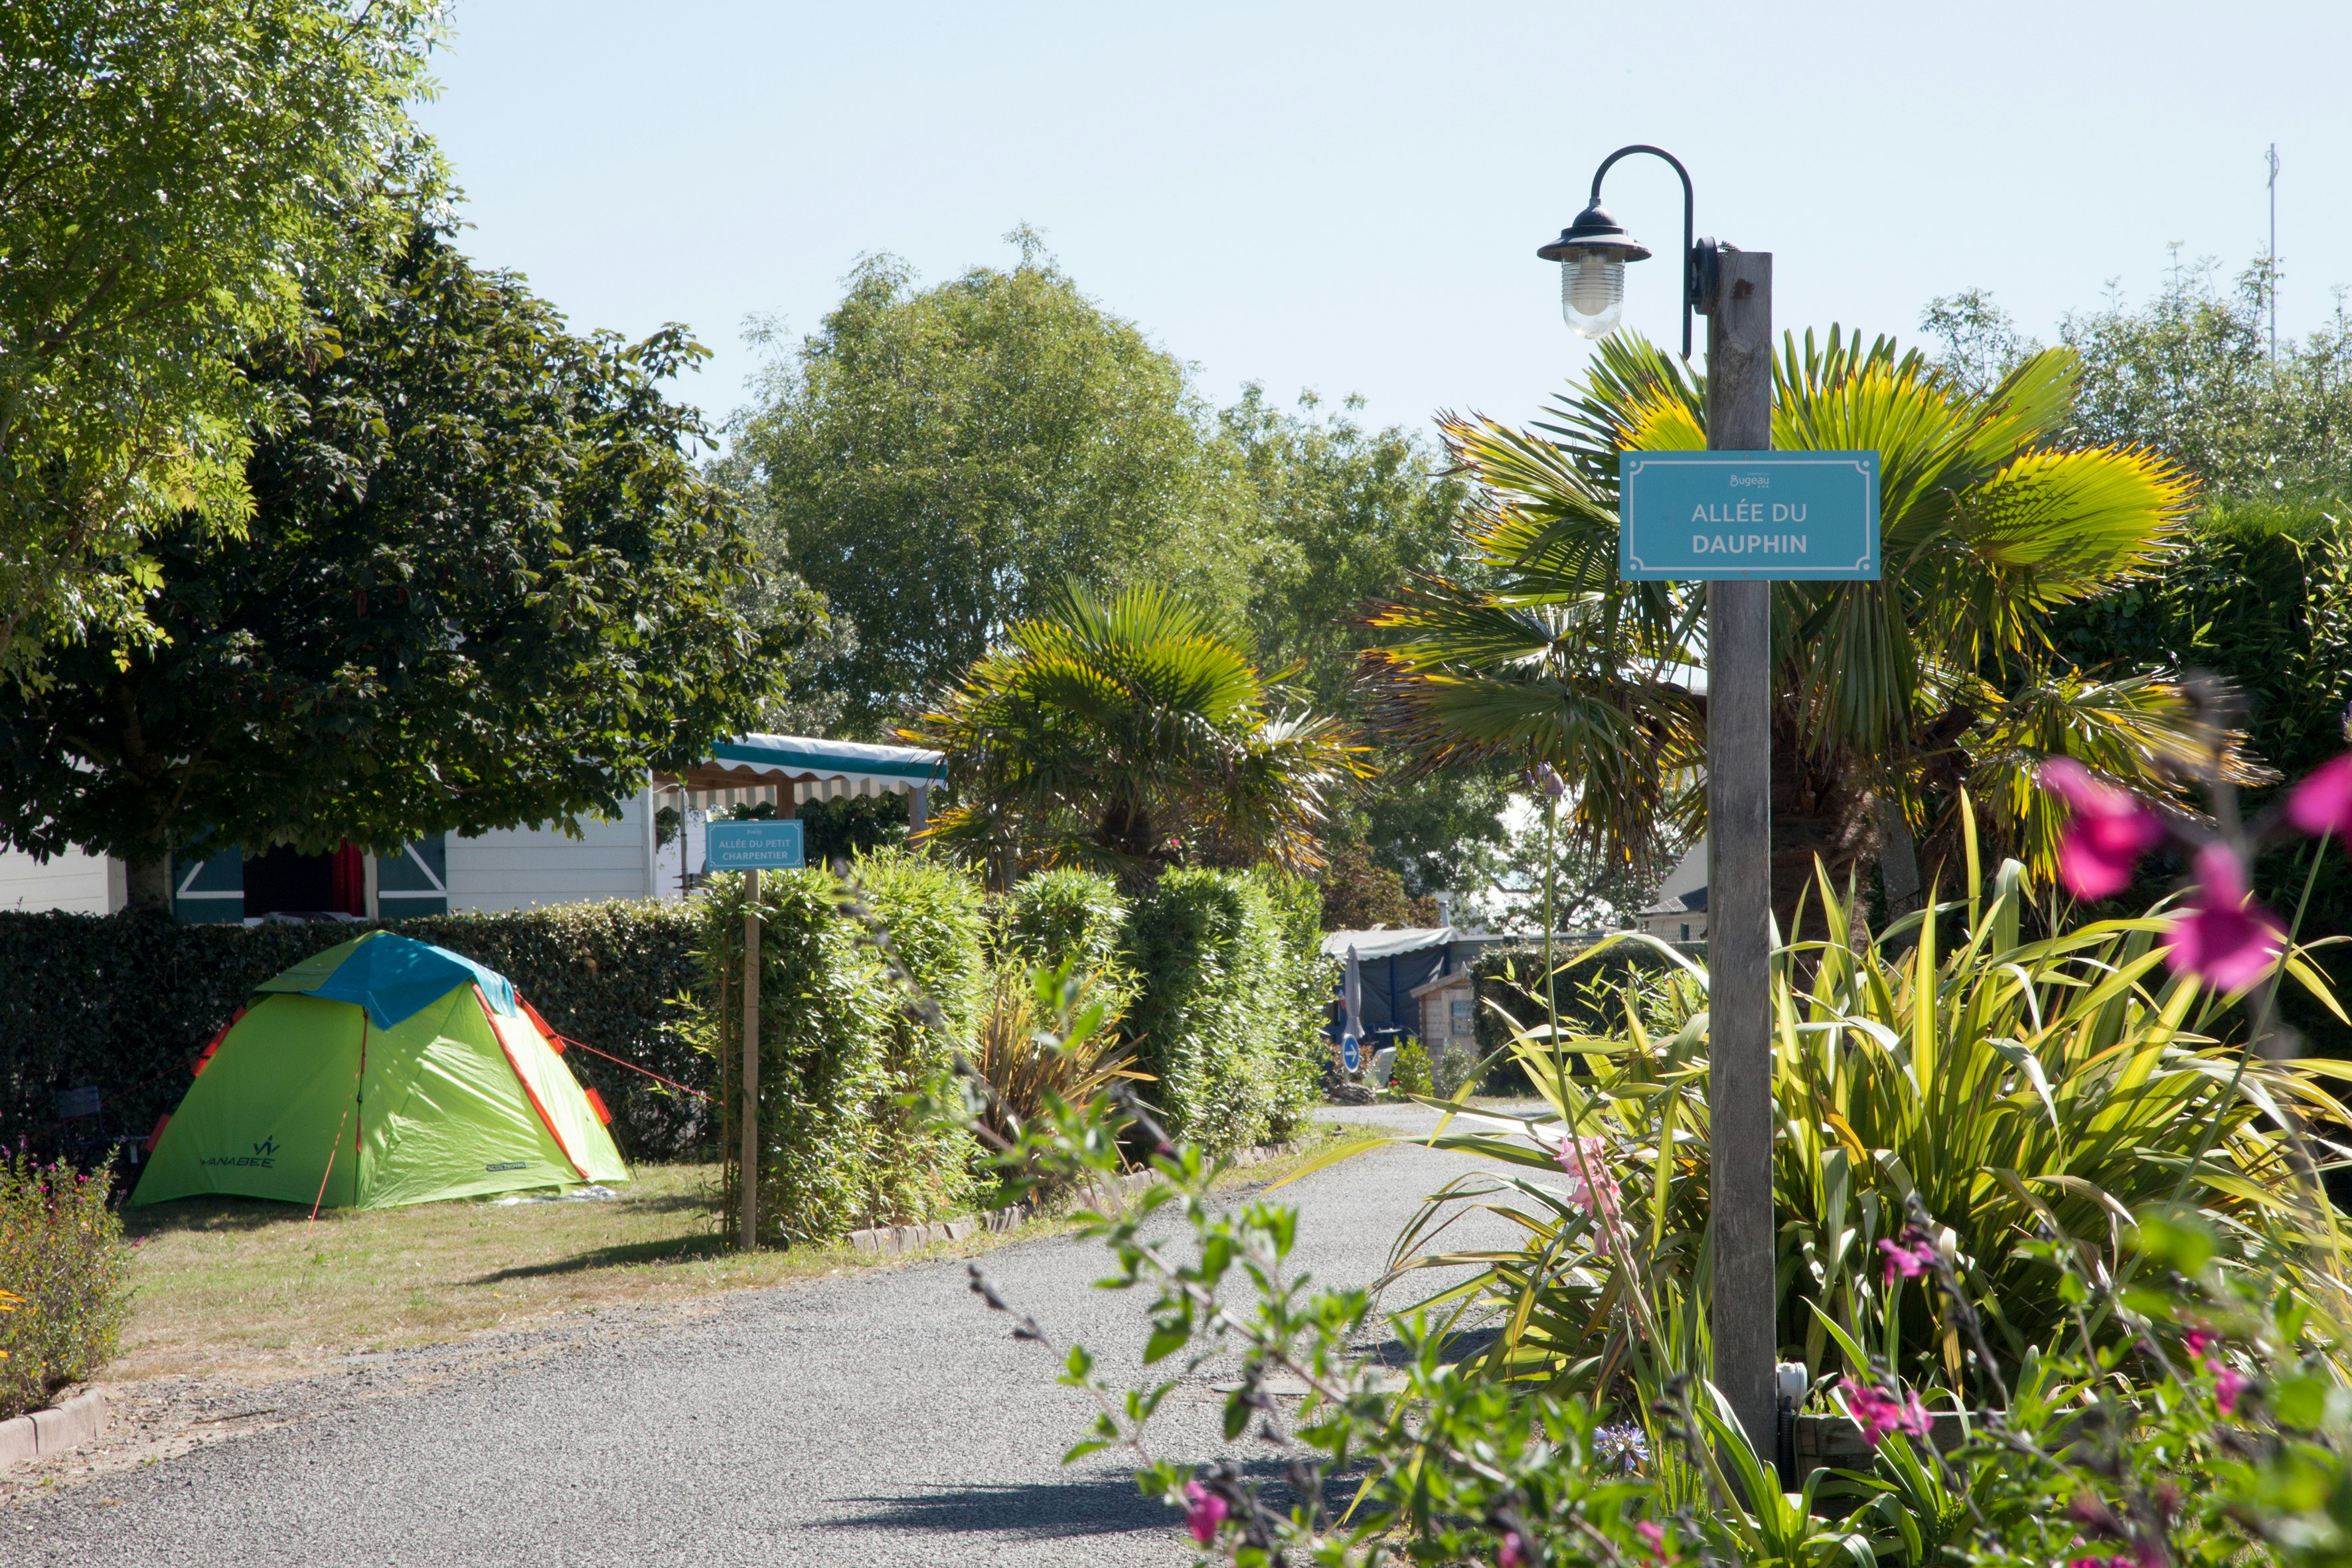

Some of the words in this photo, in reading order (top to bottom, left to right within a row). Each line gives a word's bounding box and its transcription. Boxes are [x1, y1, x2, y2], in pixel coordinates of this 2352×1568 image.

[1729, 474, 1770, 487] Bugeau
[1691, 498, 1763, 522] ALLÉE
[1772, 503, 1807, 522] DU
[1692, 534, 1807, 554] DAUPHIN
[719, 838, 747, 848] ALLÉE
[765, 839, 791, 848] PETIT
[722, 851, 788, 860] CHARPENTIER
[200, 1156, 275, 1168] WANABEE
